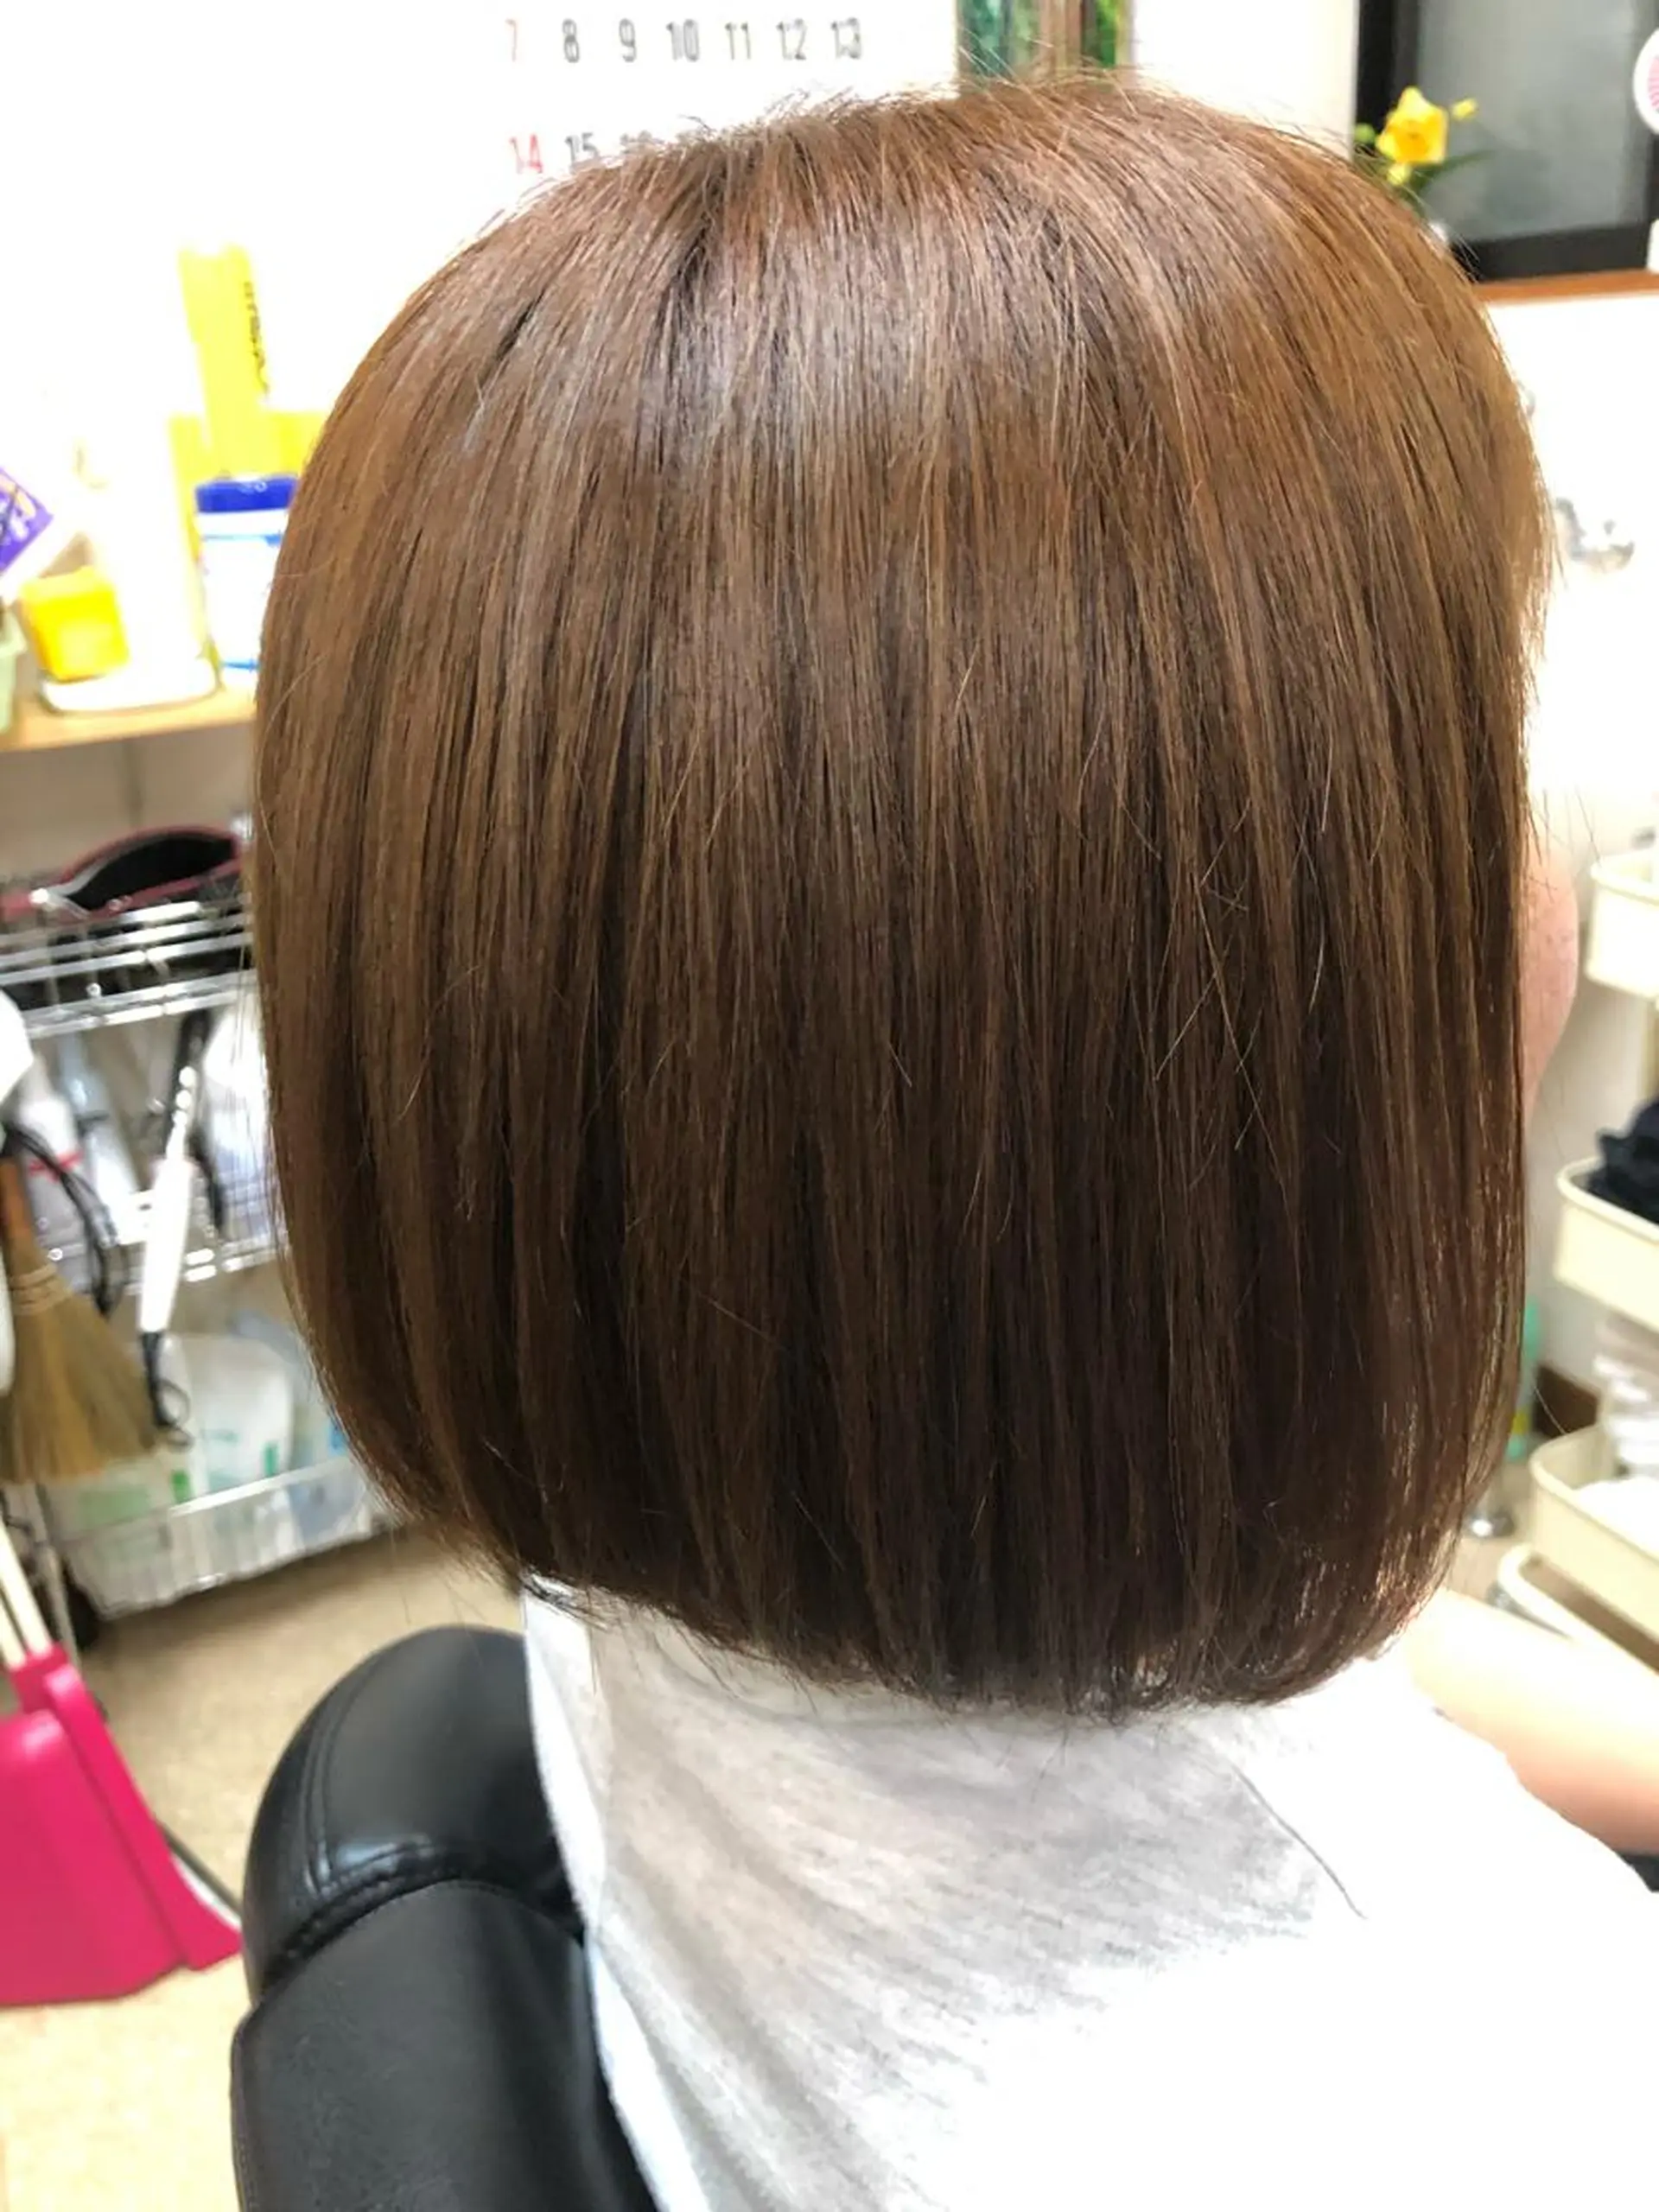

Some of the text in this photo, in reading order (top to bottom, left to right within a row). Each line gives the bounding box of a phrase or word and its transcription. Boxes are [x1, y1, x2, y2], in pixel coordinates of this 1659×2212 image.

[505, 17, 862, 64] 7 8 9 10 11 12 13
[508, 132, 544, 175] 14
[564, 132, 600, 164] 15
